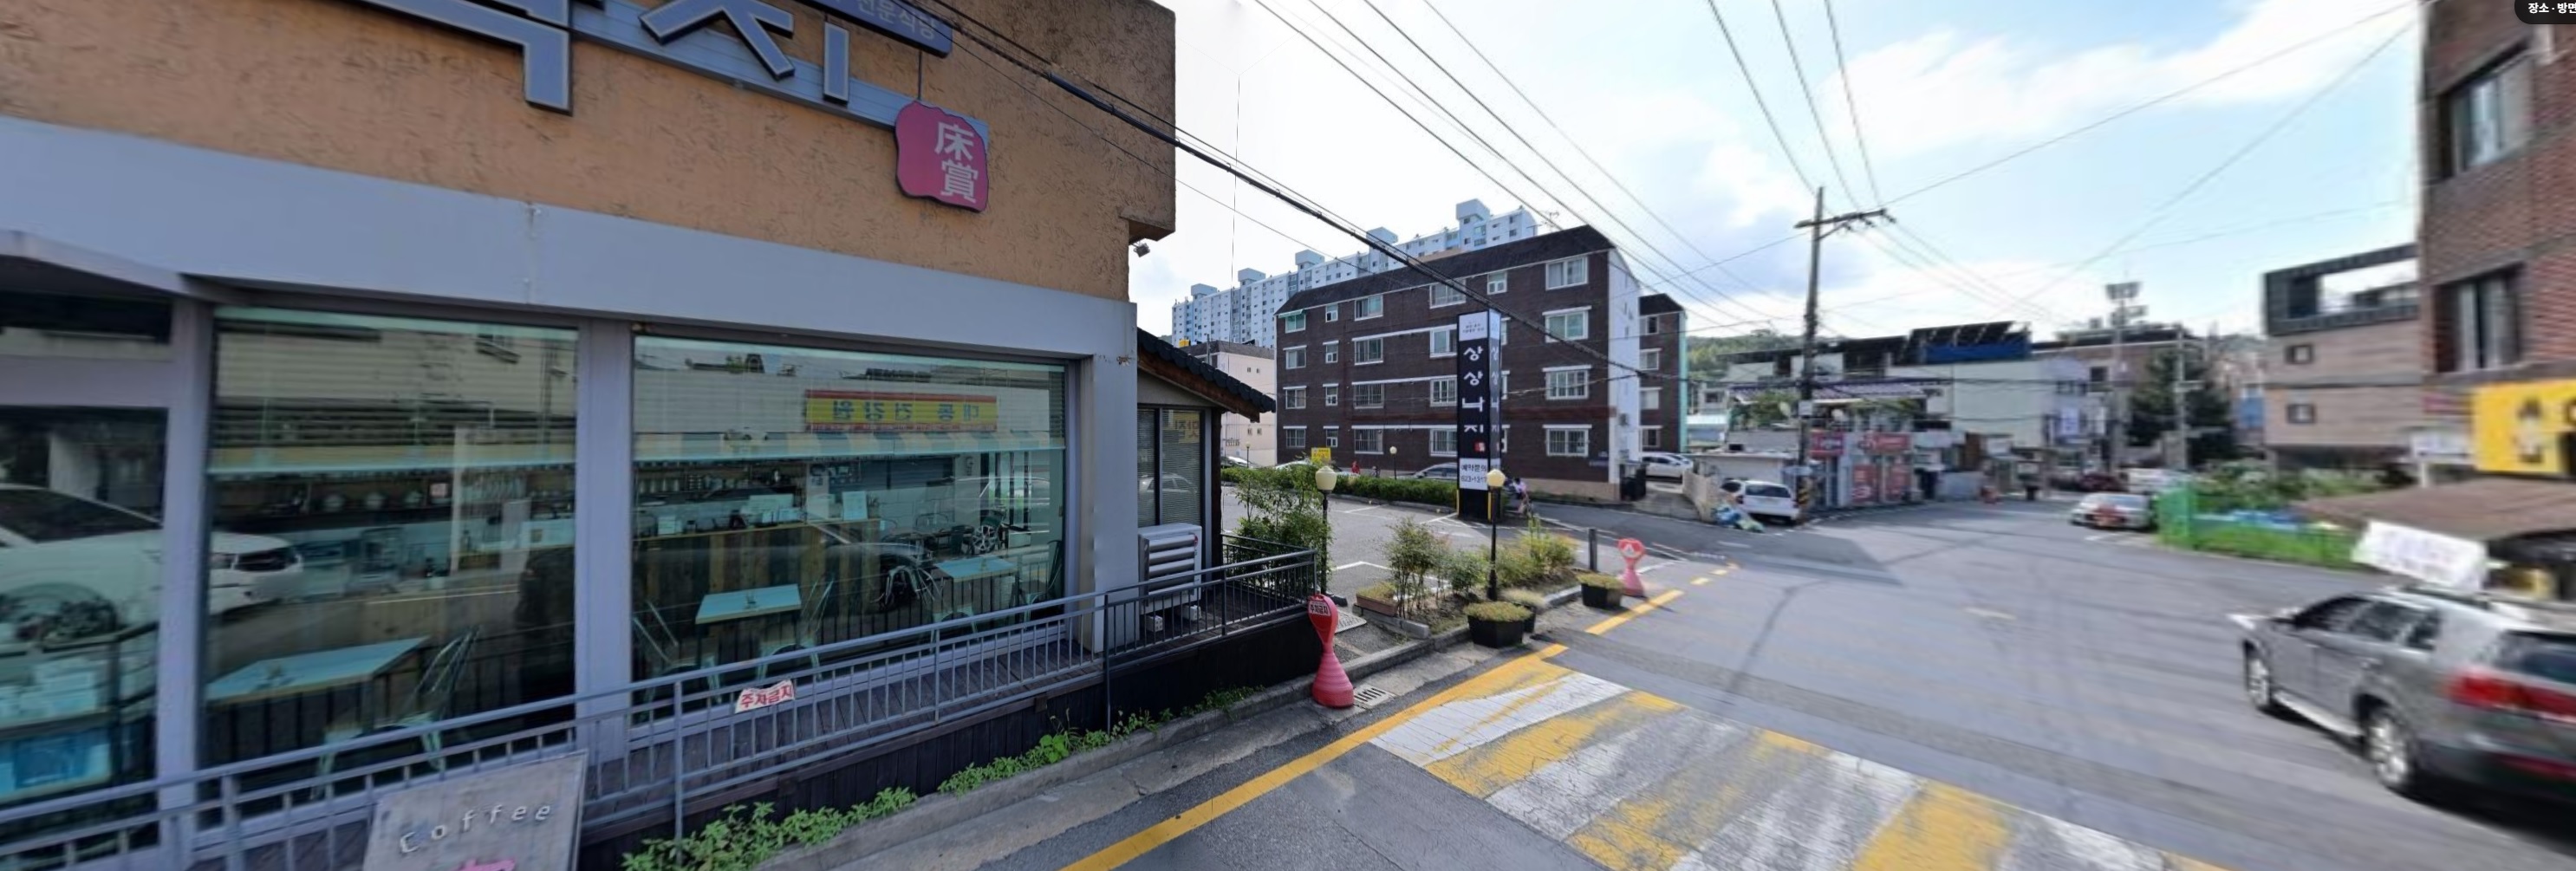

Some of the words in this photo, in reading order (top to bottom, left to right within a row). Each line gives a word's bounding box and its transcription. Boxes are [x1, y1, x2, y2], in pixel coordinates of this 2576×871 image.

[1310, 604, 1330, 614] 주차금지
[741, 685, 792, 708] 주차금지
[400, 803, 550, 854] Coffee
